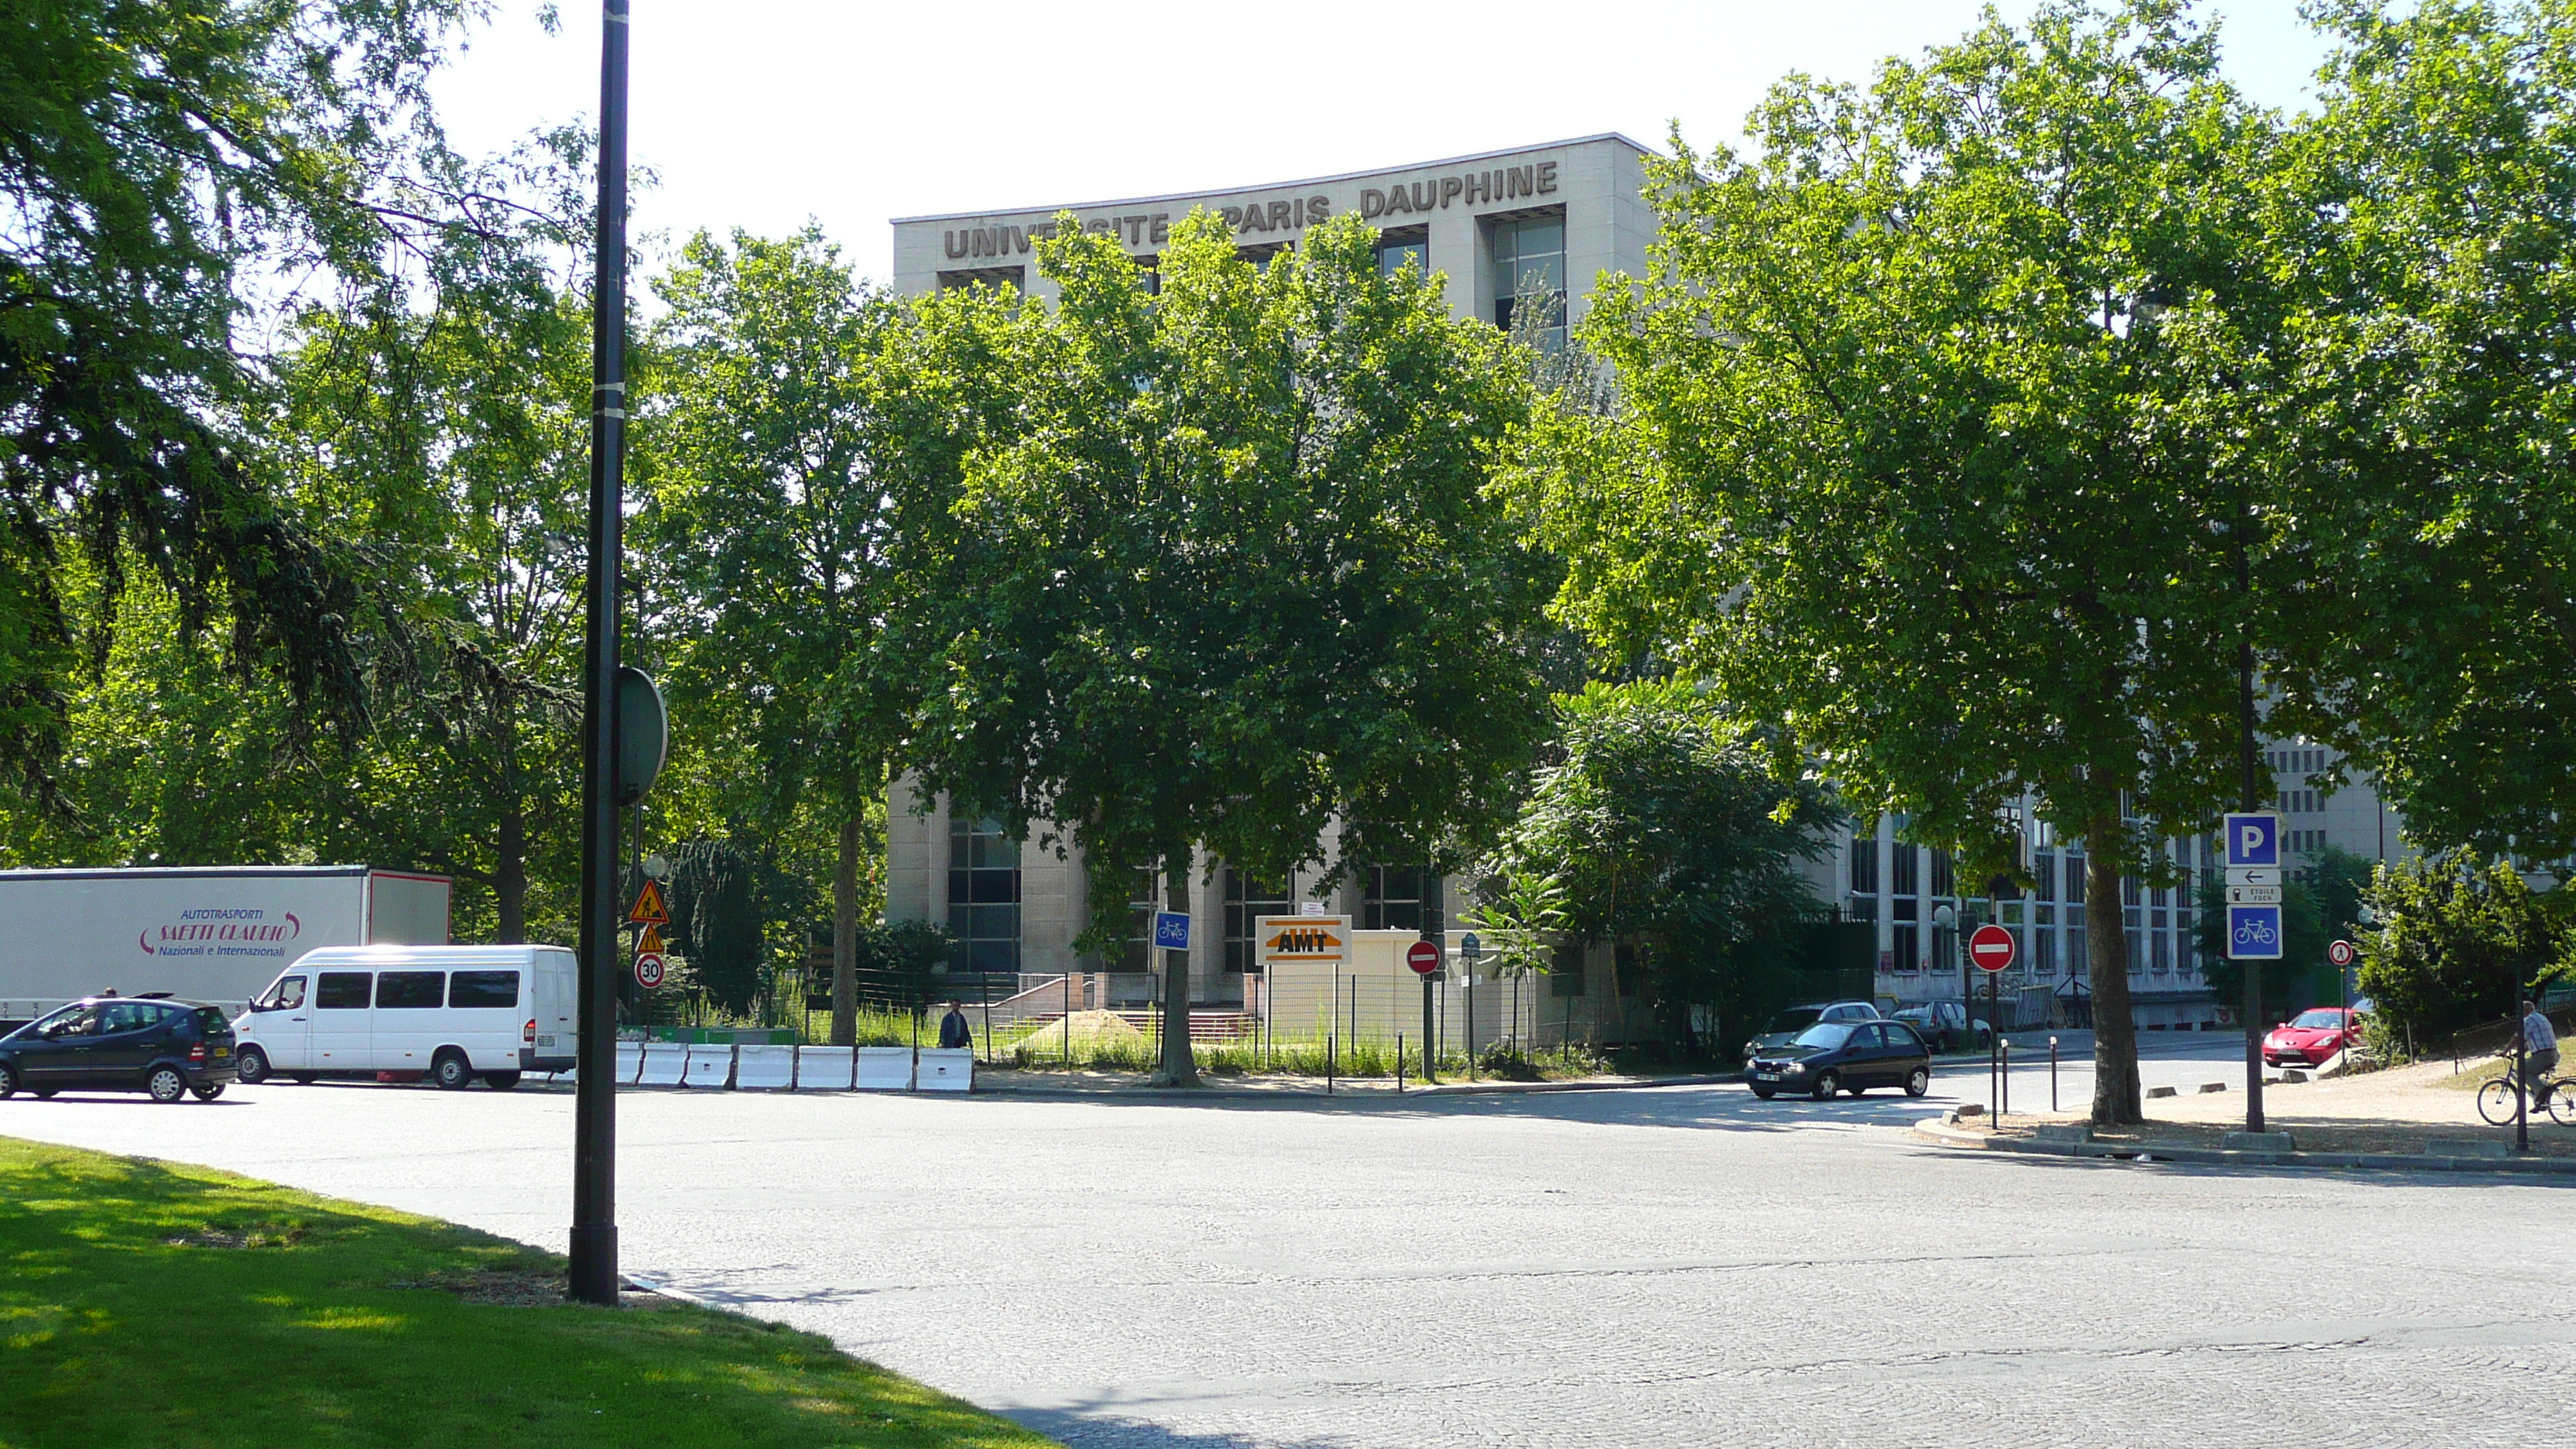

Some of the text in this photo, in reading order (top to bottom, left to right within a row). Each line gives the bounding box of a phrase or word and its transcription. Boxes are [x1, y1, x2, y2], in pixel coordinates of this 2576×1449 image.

[944, 213, 1170, 259] UNIVESITE
[1360, 161, 1557, 219] DAUPHINE
[2241, 825, 2265, 858] P
[180, 909, 264, 920] AUTOTRASPORTI
[158, 923, 289, 942] SAETTI CLAUDIO
[159, 945, 286, 957] Nazionali e Internazionali
[1277, 934, 1327, 953] AMT
[642, 964, 659, 978] 30
